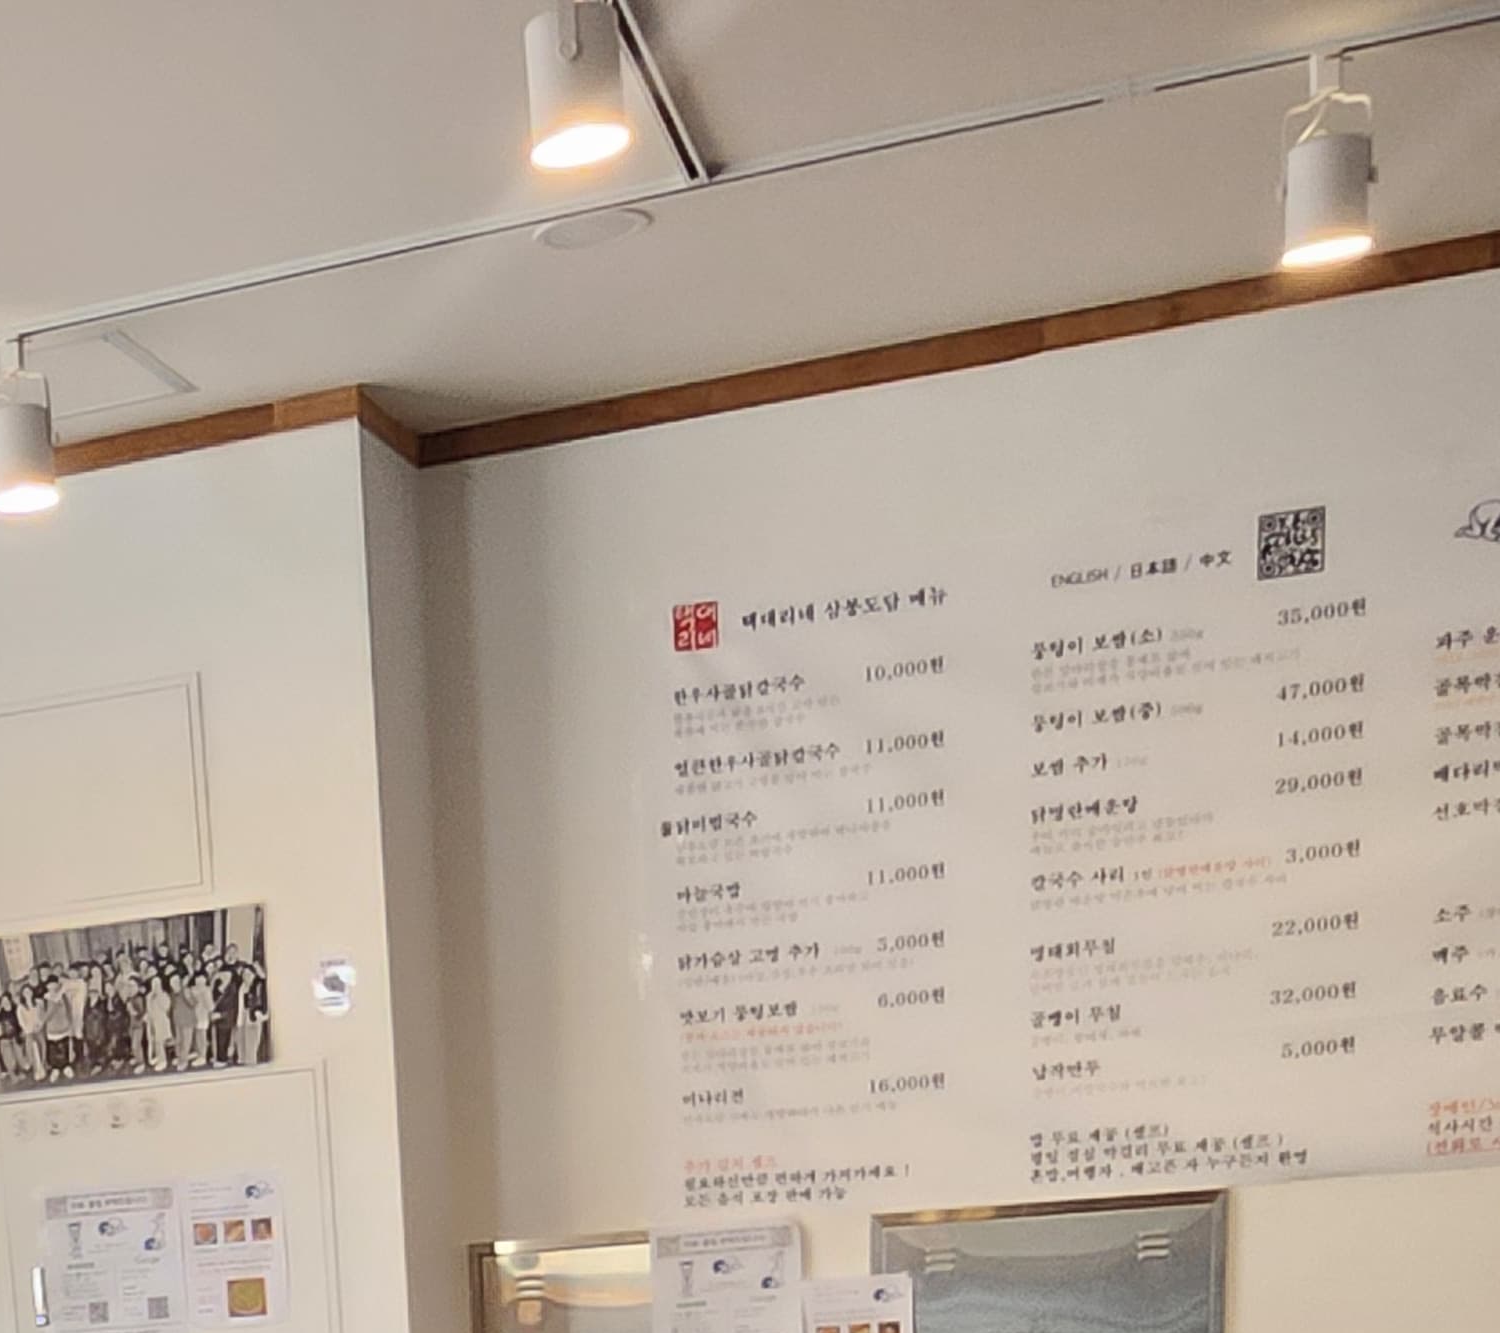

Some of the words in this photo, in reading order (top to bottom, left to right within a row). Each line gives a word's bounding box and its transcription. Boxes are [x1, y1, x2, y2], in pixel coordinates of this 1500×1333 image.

[1050, 567, 1109, 588] ENGLISH
[1198, 549, 1233, 569] 中文
[908, 585, 948, 607] 메뉴
[1277, 597, 1367, 627] 35,000원
[864, 655, 945, 683] 10,000원
[1275, 673, 1366, 702] 47,000원
[865, 730, 945, 755] 11,000원
[1276, 720, 1365, 748] 14,000원
[1434, 720, 1500, 746] 골목막
[1073, 752, 1108, 774] 추가
[1274, 767, 1363, 795] 29,000원
[865, 788, 945, 815] 11,000원
[1284, 838, 1361, 865] 3,000원
[866, 861, 946, 887] 11,000원
[1030, 869, 1084, 891] 칼국수
[1091, 865, 1125, 885] 사리
[1271, 910, 1359, 938] 22,000원
[1433, 903, 1472, 925] 소주
[787, 941, 820, 961] 추가
[876, 929, 946, 954] 5,000원
[1431, 944, 1470, 965] 맥주
[877, 986, 946, 1010] 6,000원
[1269, 980, 1357, 1006] 32,000원
[1430, 983, 1489, 1006] 음료수
[1088, 1004, 1122, 1025] 무침
[1280, 1035, 1356, 1060] 5,000원
[867, 1072, 946, 1096] 16,000원
[1051, 1129, 1080, 1147] 무료
[1156, 1139, 1186, 1158] 무료
[1277, 1148, 1309, 1167] 환영
[818, 1185, 848, 1201] 가능
